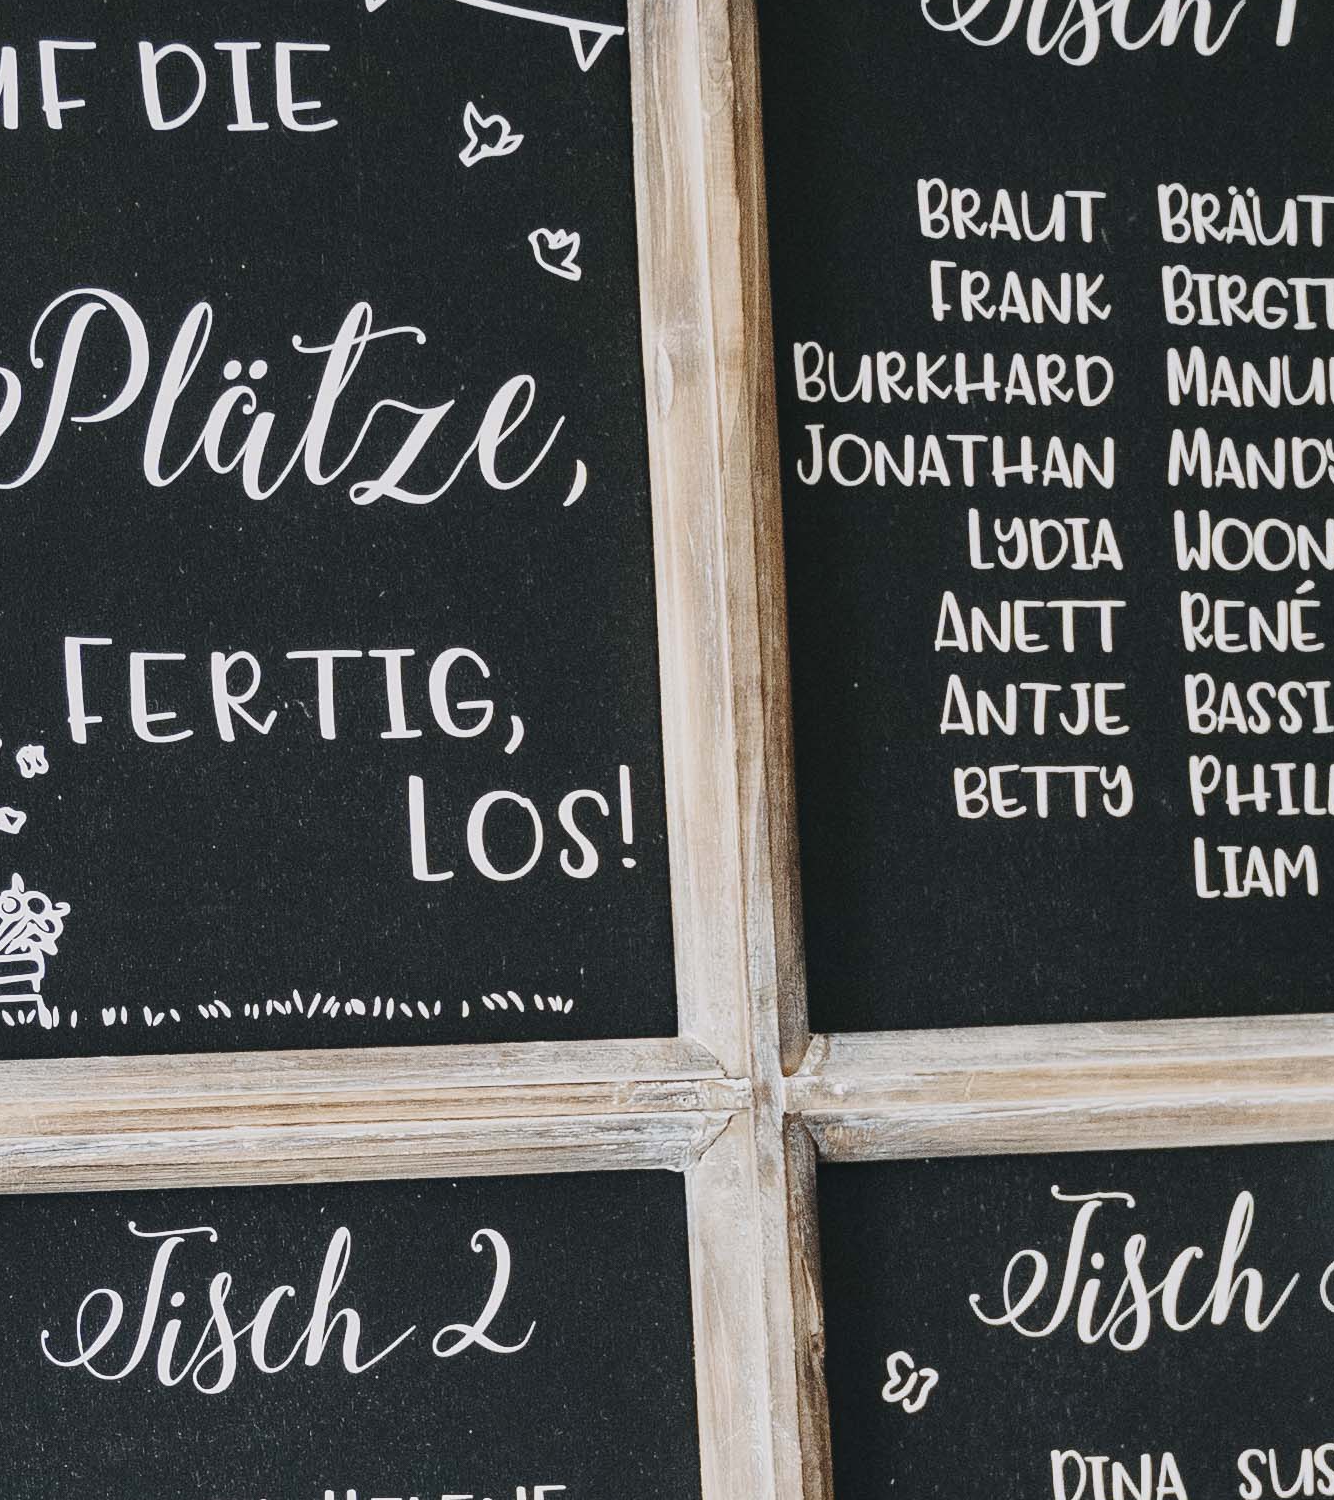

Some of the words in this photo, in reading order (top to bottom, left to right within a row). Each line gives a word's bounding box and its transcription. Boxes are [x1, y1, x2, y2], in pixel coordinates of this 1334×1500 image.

[137, 39, 340, 133] DIE
[916, 176, 1108, 244] BRAUT
[929, 258, 1113, 326] FRANK
[792, 340, 1115, 408] BURKHARD
[796, 423, 1116, 491] JONATHAN
[967, 506, 1125, 572] LYDIA
[933, 589, 1128, 654] ANETT
[1179, 578, 1326, 654] RENÉ
[63, 635, 526, 756] FERTIG,
[938, 672, 1131, 737] ANTJE
[407, 763, 638, 883] LOS!
[952, 763, 1135, 820] BETTY
[1192, 835, 1320, 900] LIAM
[967, 1183, 1301, 1353] Tisch
[39, 1219, 418, 1396] Tisch
[431, 1227, 538, 1359] 2
